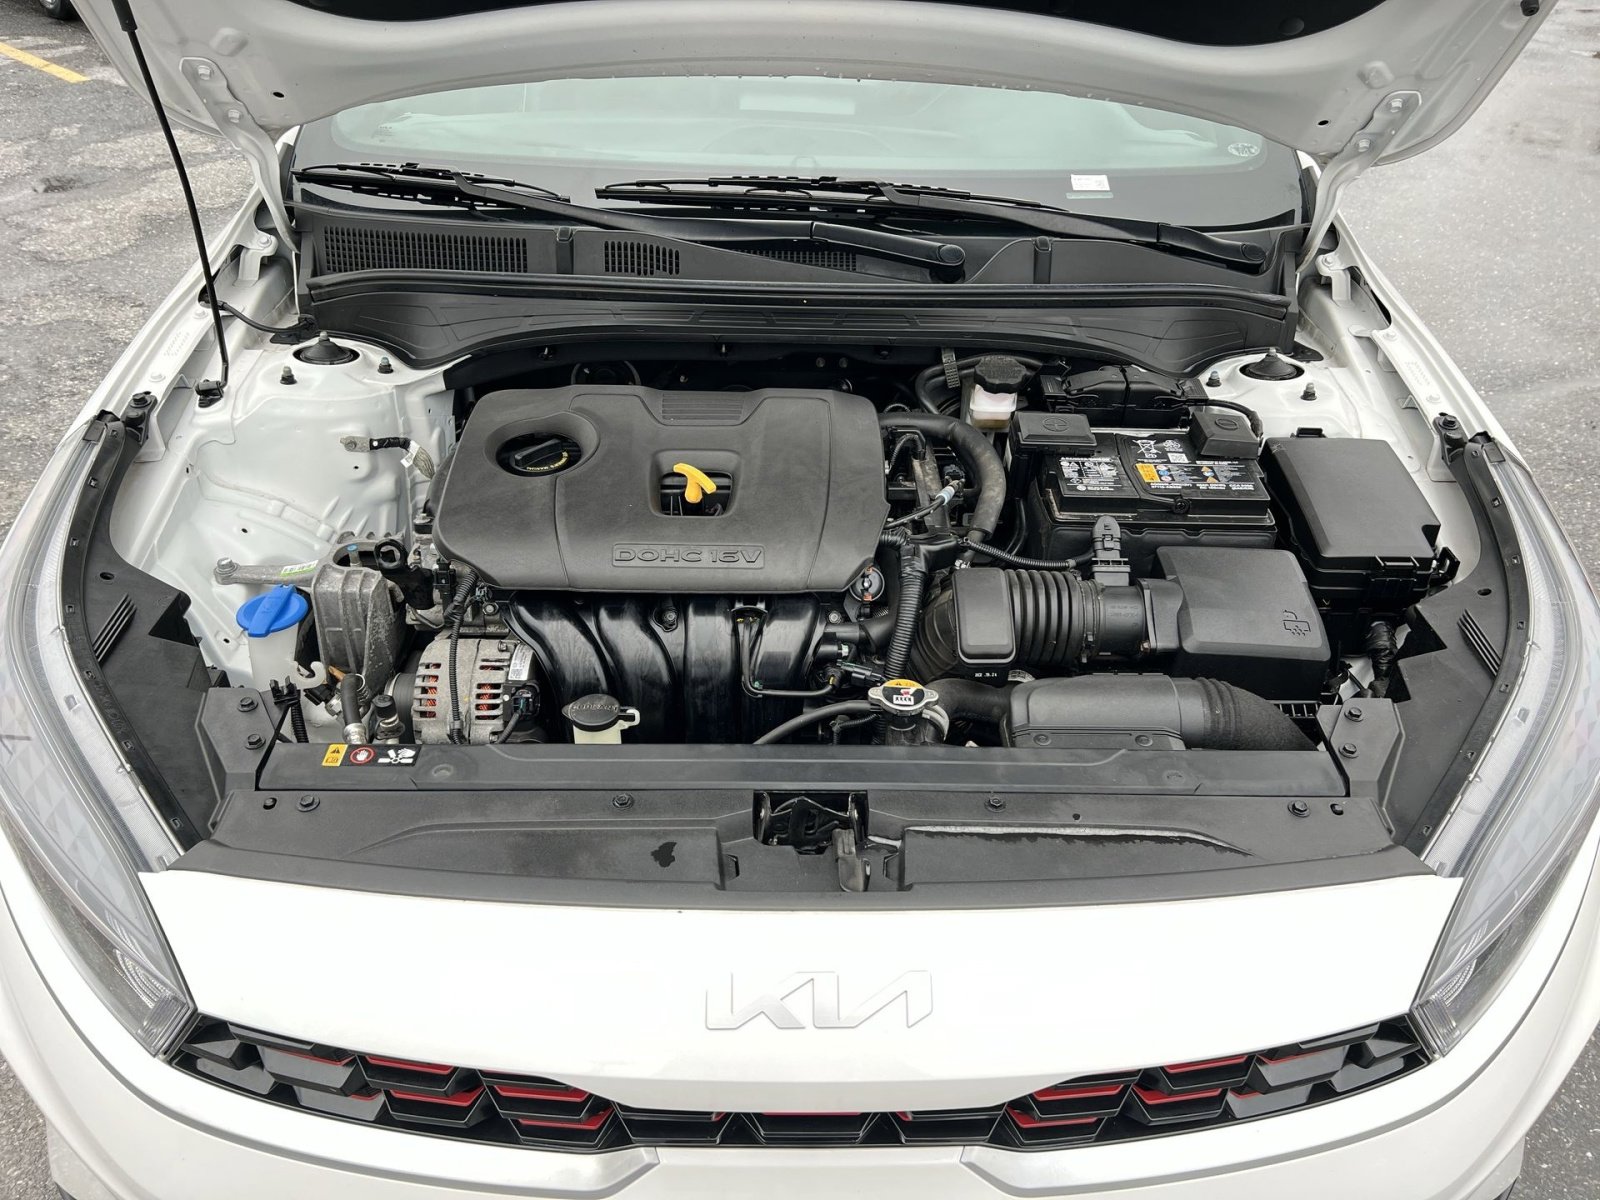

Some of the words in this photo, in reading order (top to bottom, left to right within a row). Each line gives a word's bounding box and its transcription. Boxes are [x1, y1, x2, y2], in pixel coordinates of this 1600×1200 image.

[614, 548, 702, 563] DOHC
[709, 549, 762, 564] 16V
[705, 970, 933, 1030] KIA
